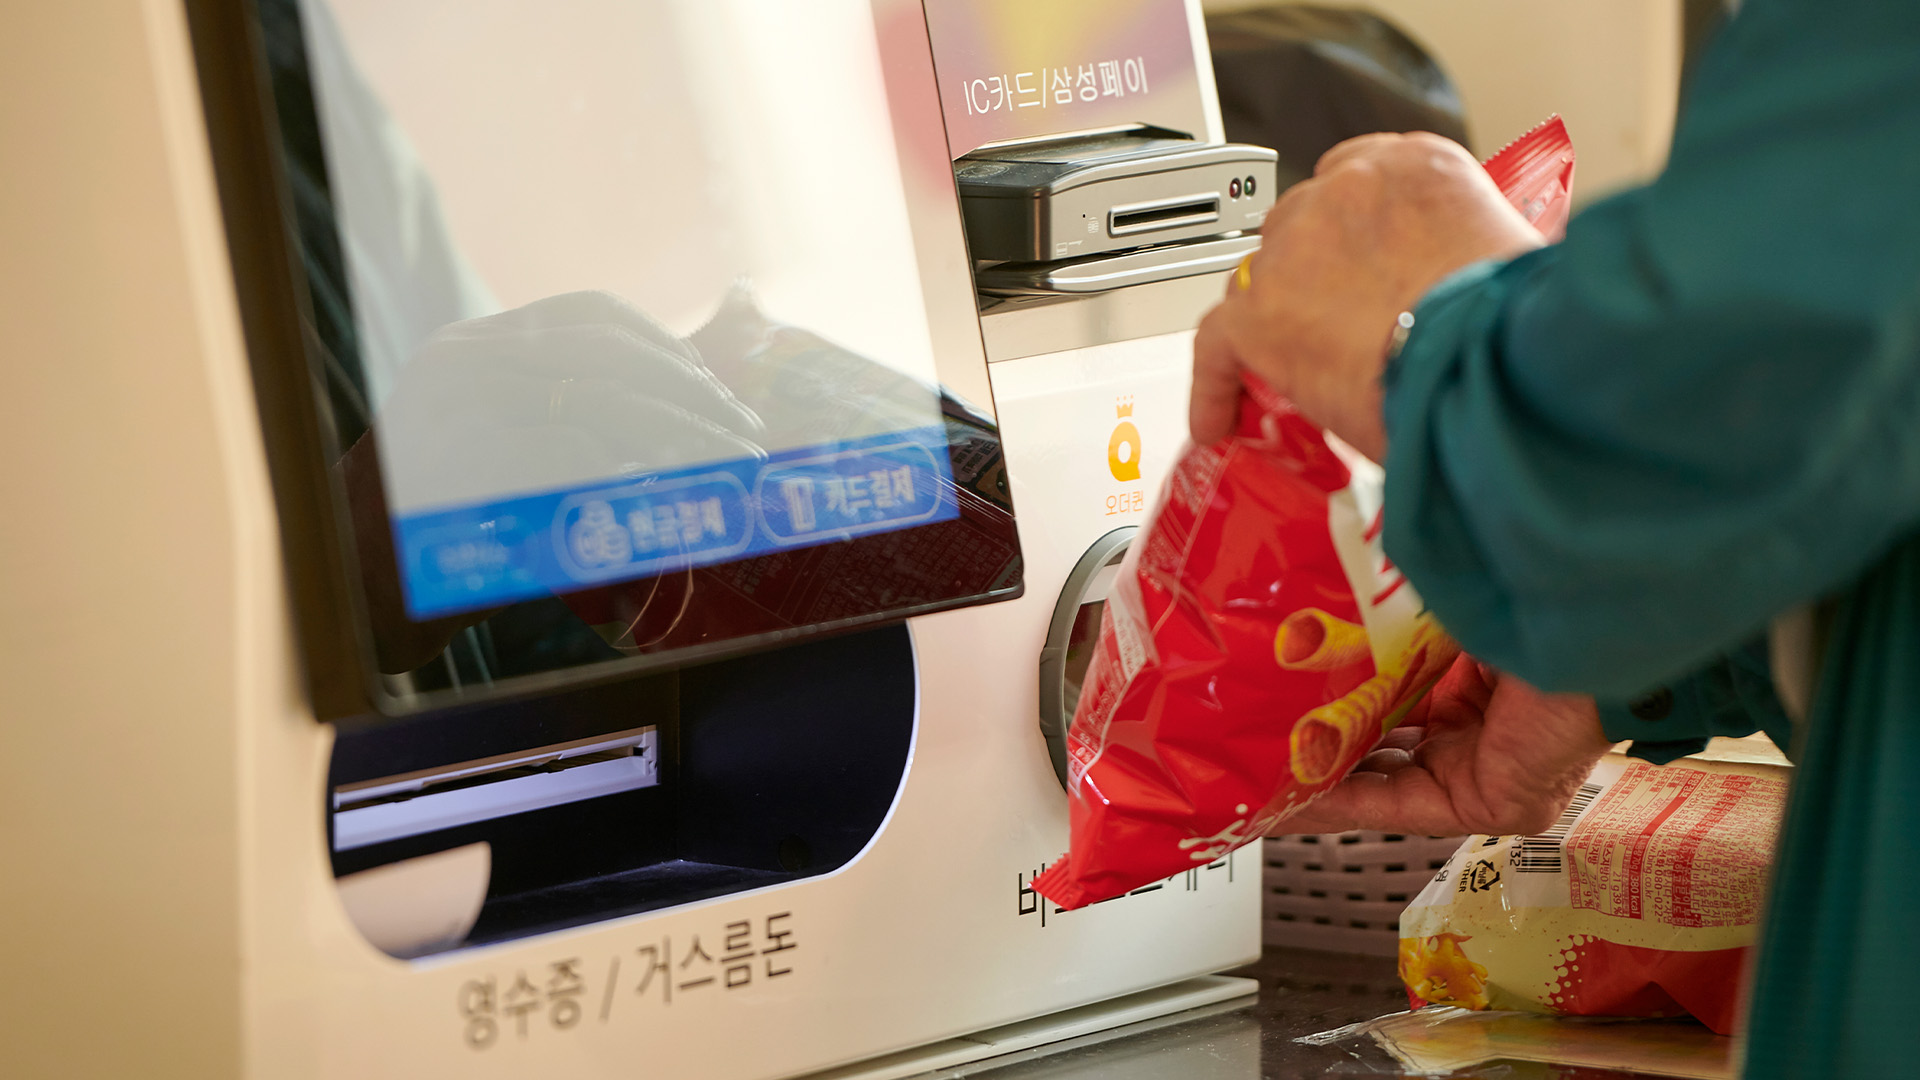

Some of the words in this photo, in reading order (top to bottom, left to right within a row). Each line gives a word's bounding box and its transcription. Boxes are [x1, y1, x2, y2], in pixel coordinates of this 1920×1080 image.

[964, 57, 1149, 115] IC카드/삼성페이
[1105, 490, 1144, 516] 오더퀸
[1675, 772, 1705, 797] 영양정보
[1458, 861, 1472, 893] OTHER
[1630, 874, 1639, 893] 380
[1612, 891, 1621, 904] 39
[1630, 895, 1640, 914] kcal
[457, 957, 588, 1051] 영수증
[598, 955, 621, 1022] /
[636, 912, 797, 1005] 거스름돈
